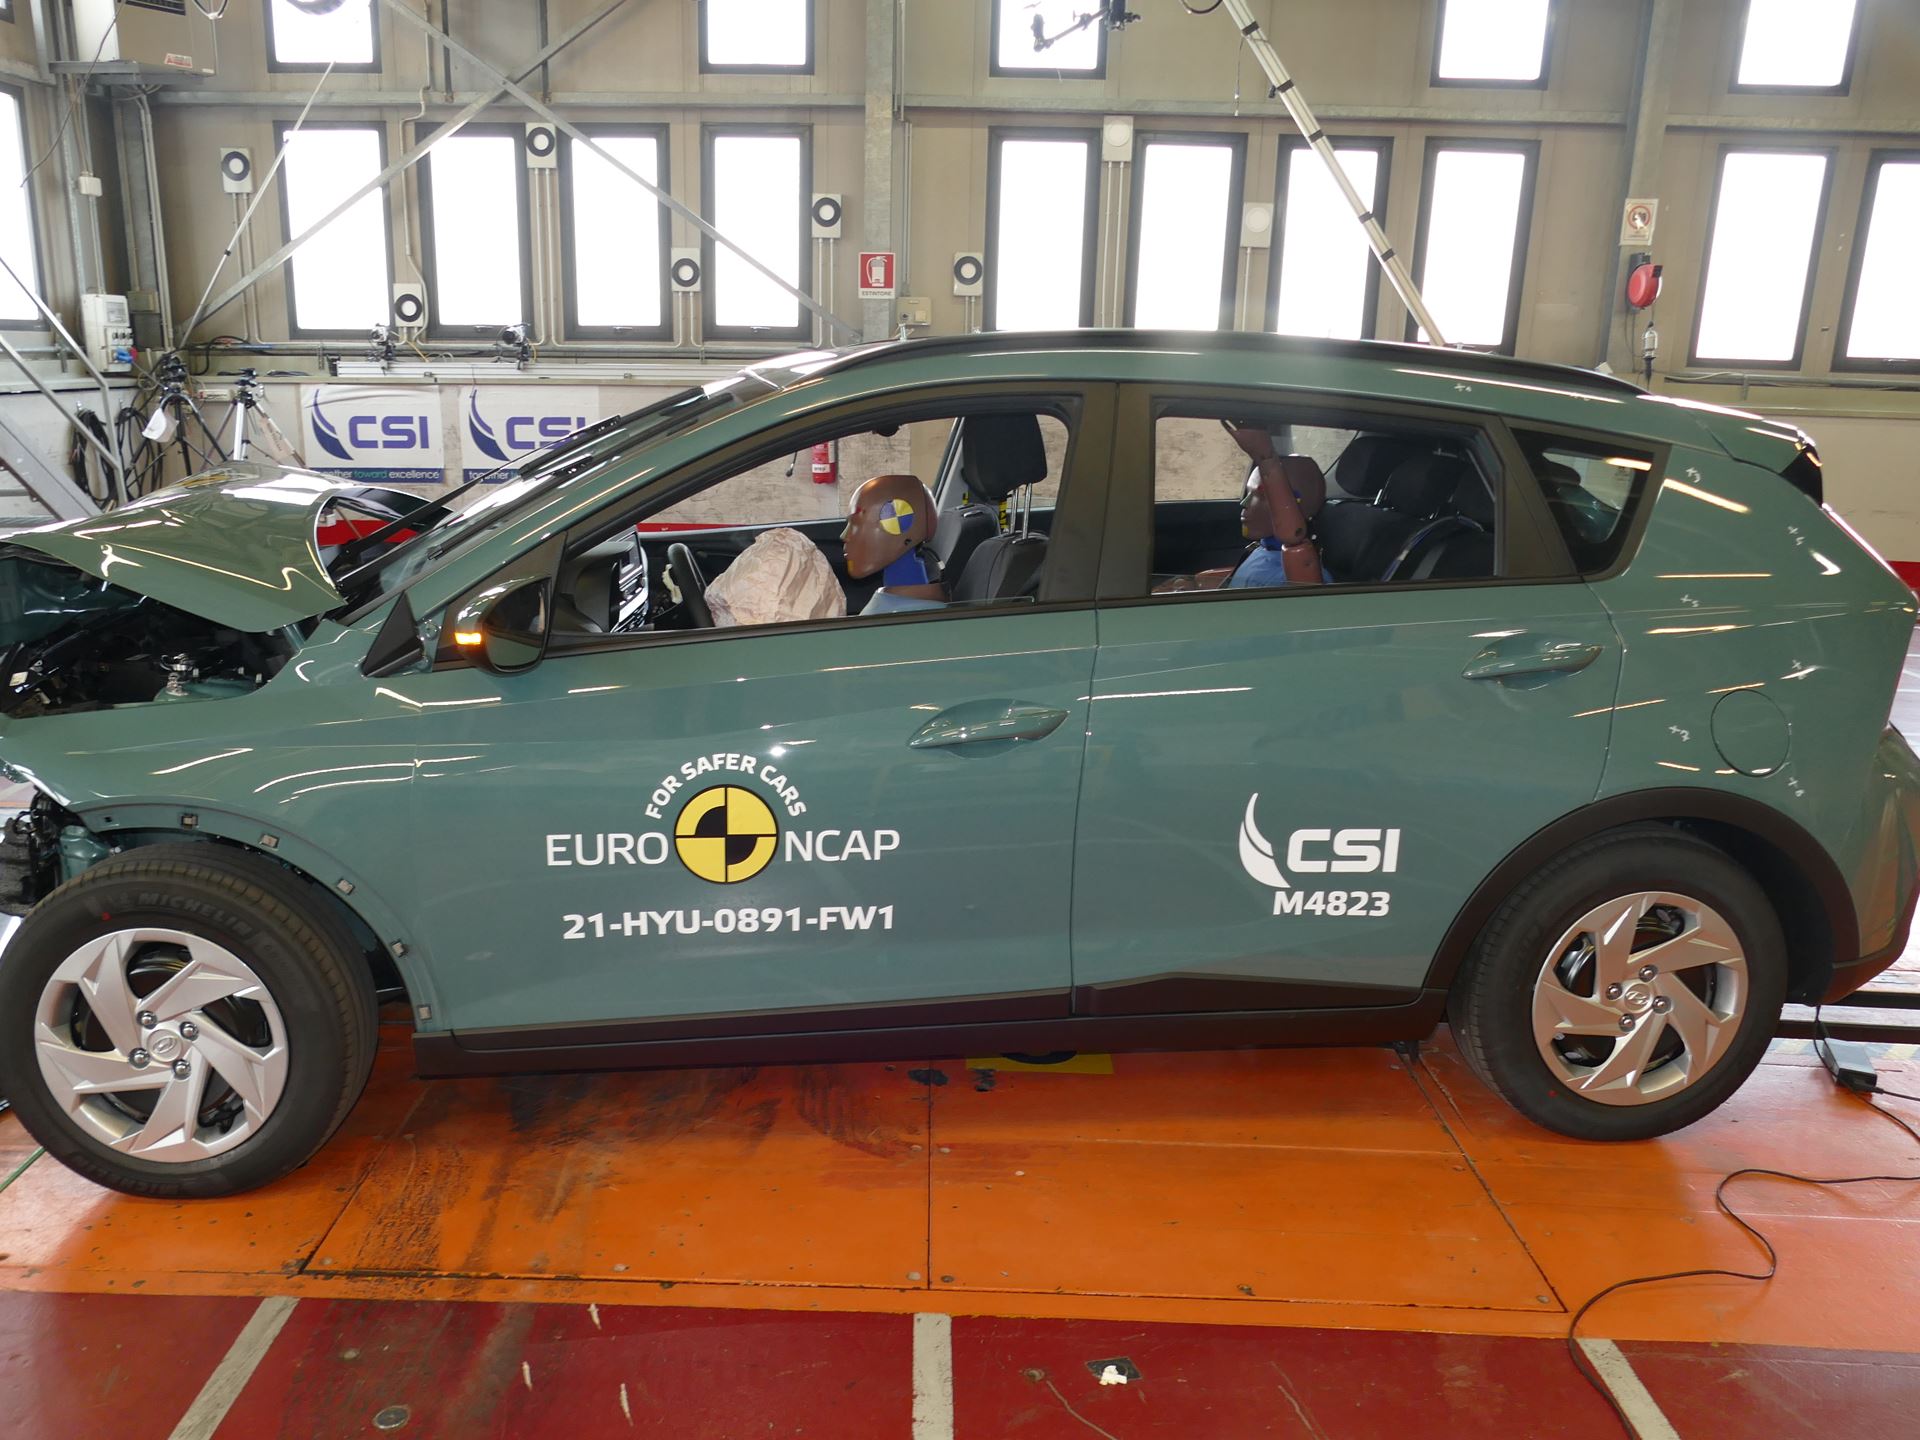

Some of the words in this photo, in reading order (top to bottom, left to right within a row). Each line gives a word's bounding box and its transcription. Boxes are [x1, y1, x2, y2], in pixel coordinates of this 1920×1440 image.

[348, 415, 430, 449] CSI
[353, 469, 388, 479] toward
[388, 469, 441, 480] excellence
[644, 774, 684, 820] FOR
[680, 752, 758, 782] SAFER
[759, 764, 807, 818] CARS
[545, 831, 669, 867] EURO
[784, 829, 901, 862] NCAP
[1286, 828, 1401, 873] CSI
[138, 891, 254, 940] MICHELIN
[562, 904, 895, 940] 21-HYU-0891-FW1
[1272, 890, 1391, 917] M4823
